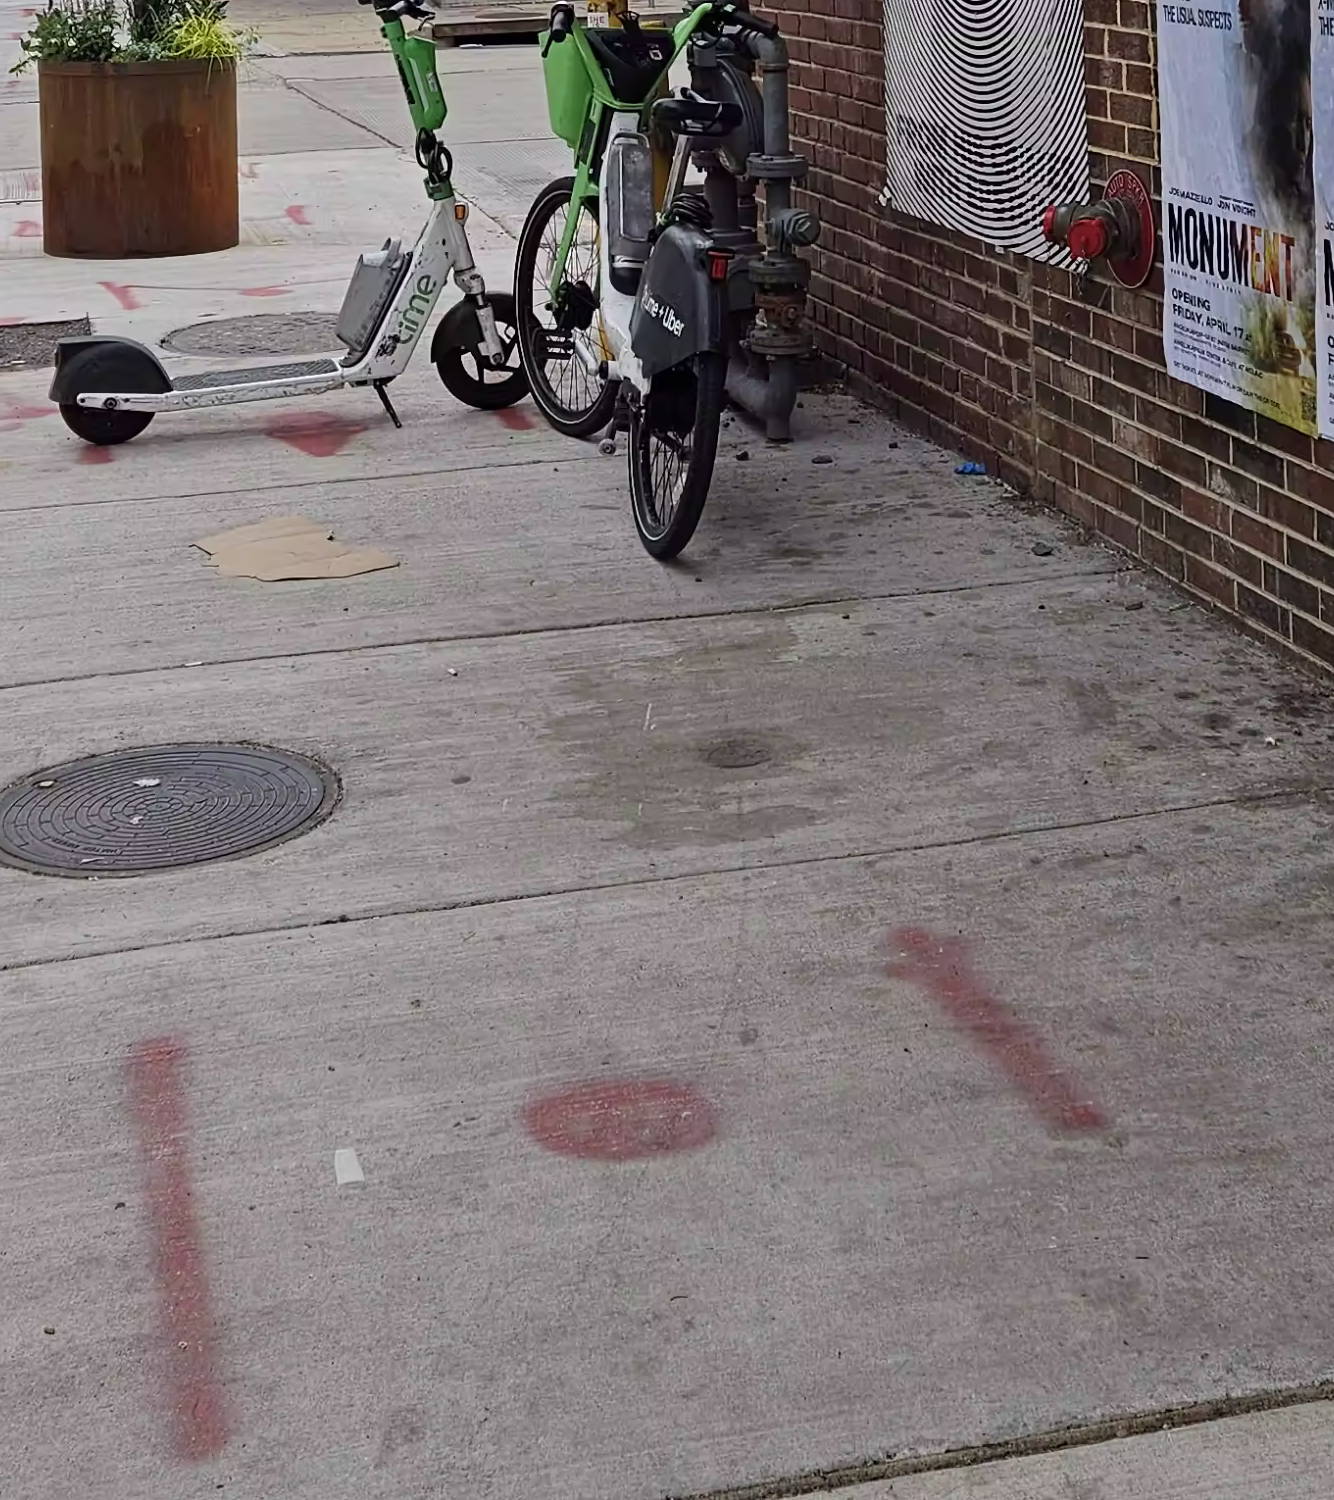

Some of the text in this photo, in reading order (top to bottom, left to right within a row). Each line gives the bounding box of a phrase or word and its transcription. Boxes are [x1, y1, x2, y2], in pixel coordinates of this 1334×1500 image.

[1108, 173, 1125, 197] AUTO
[1168, 202, 1296, 303] MONUMENT
[663, 307, 685, 338] Uber
[1205, 315, 1231, 336] APRIL
[1232, 325, 1244, 339] 17
